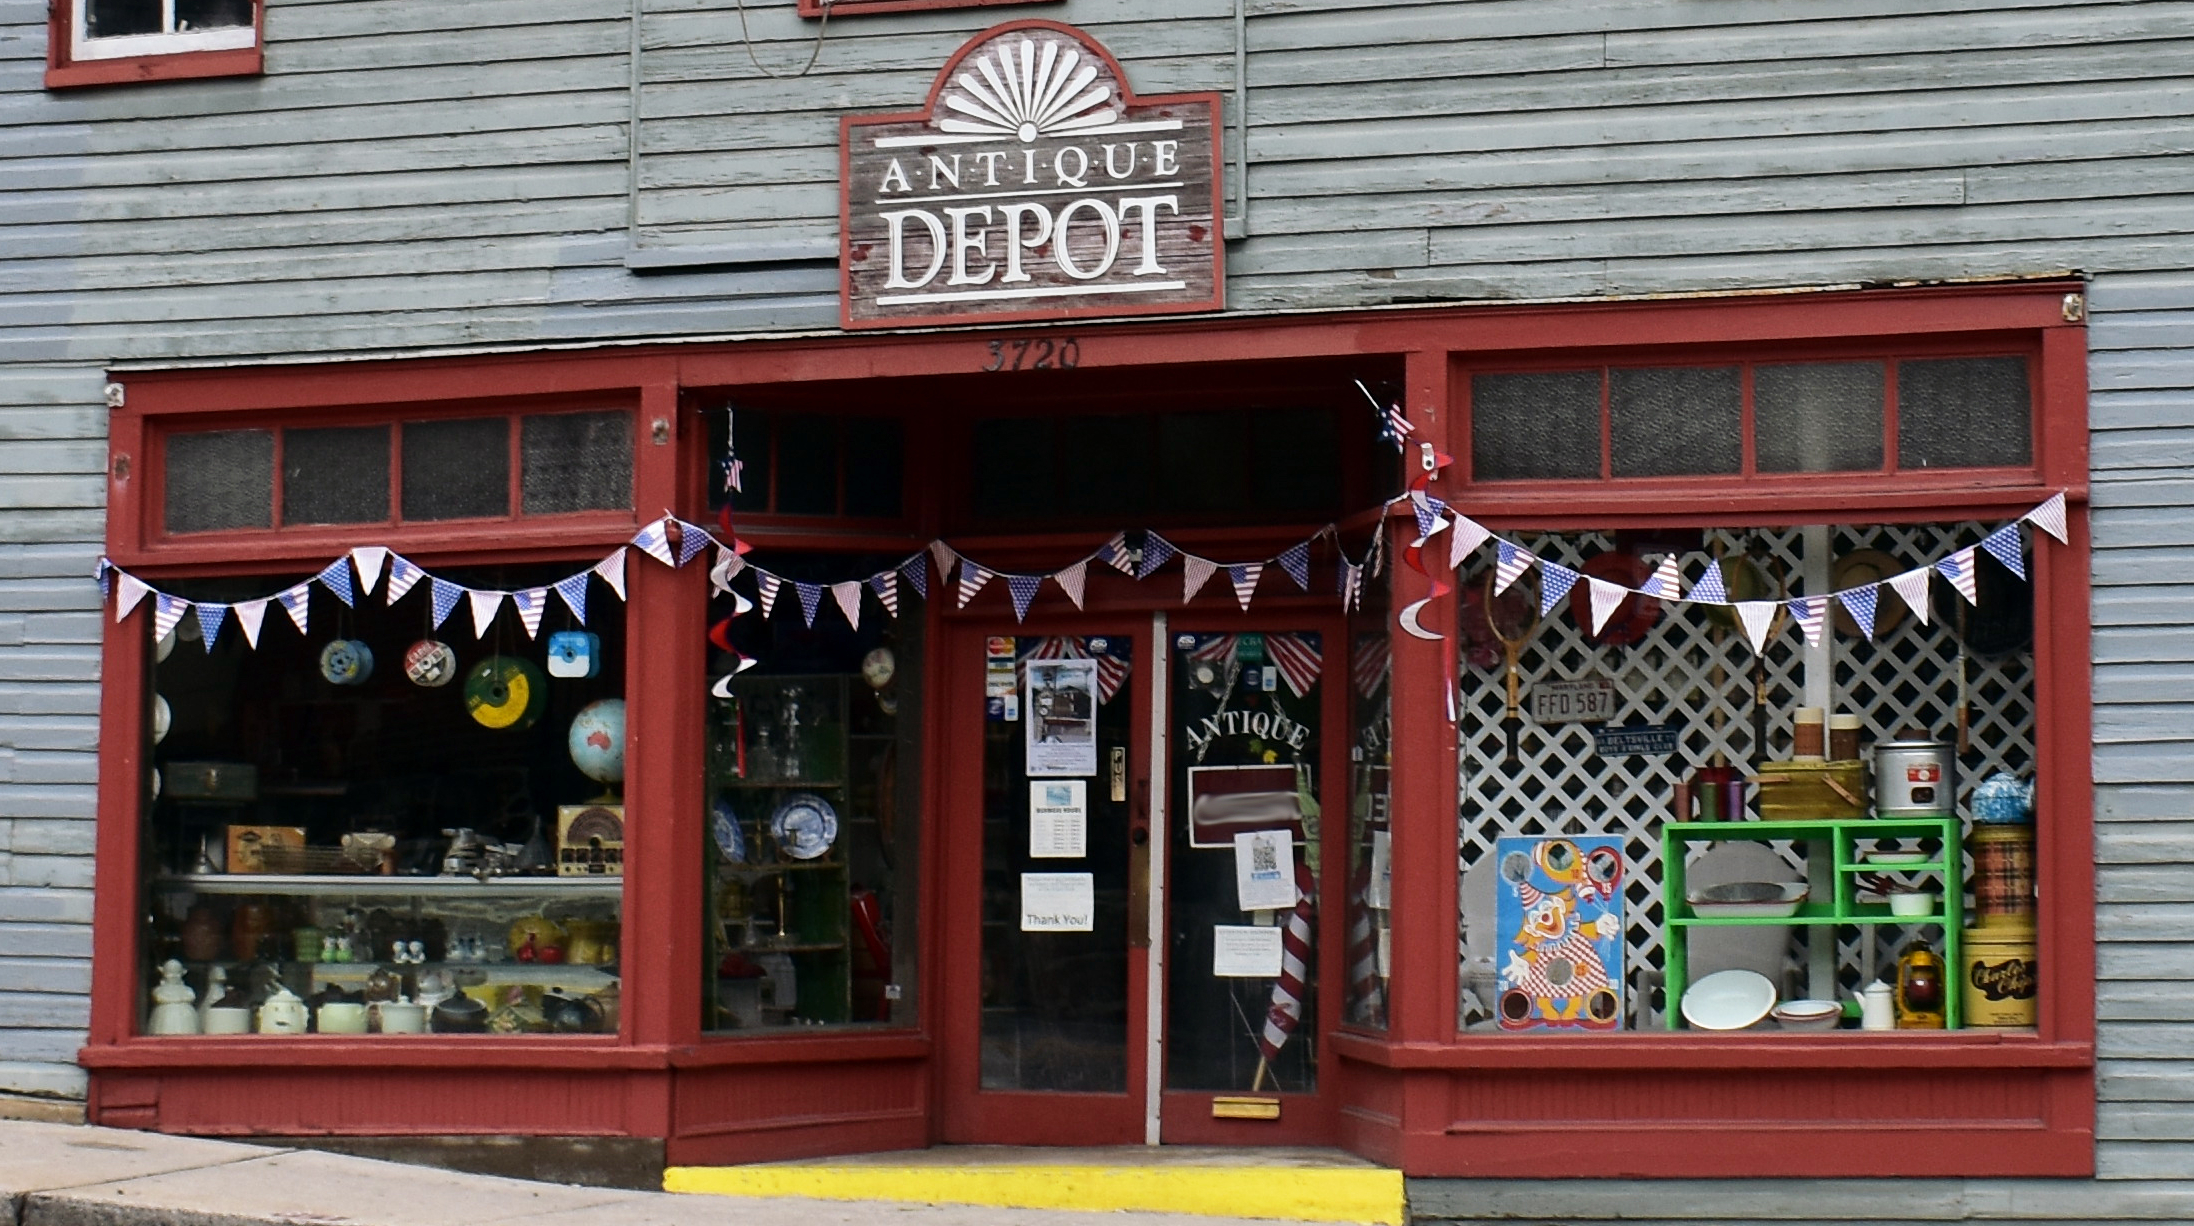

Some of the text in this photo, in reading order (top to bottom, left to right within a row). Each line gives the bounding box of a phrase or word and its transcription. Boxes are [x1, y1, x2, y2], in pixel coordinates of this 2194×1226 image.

[879, 195, 1178, 289] DEPOT
[983, 337, 1079, 372] 3720
[1576, 691, 1608, 714] 587
[1186, 710, 1311, 751] ANTIQUE
[1027, 913, 1088, 926] Thank You!
